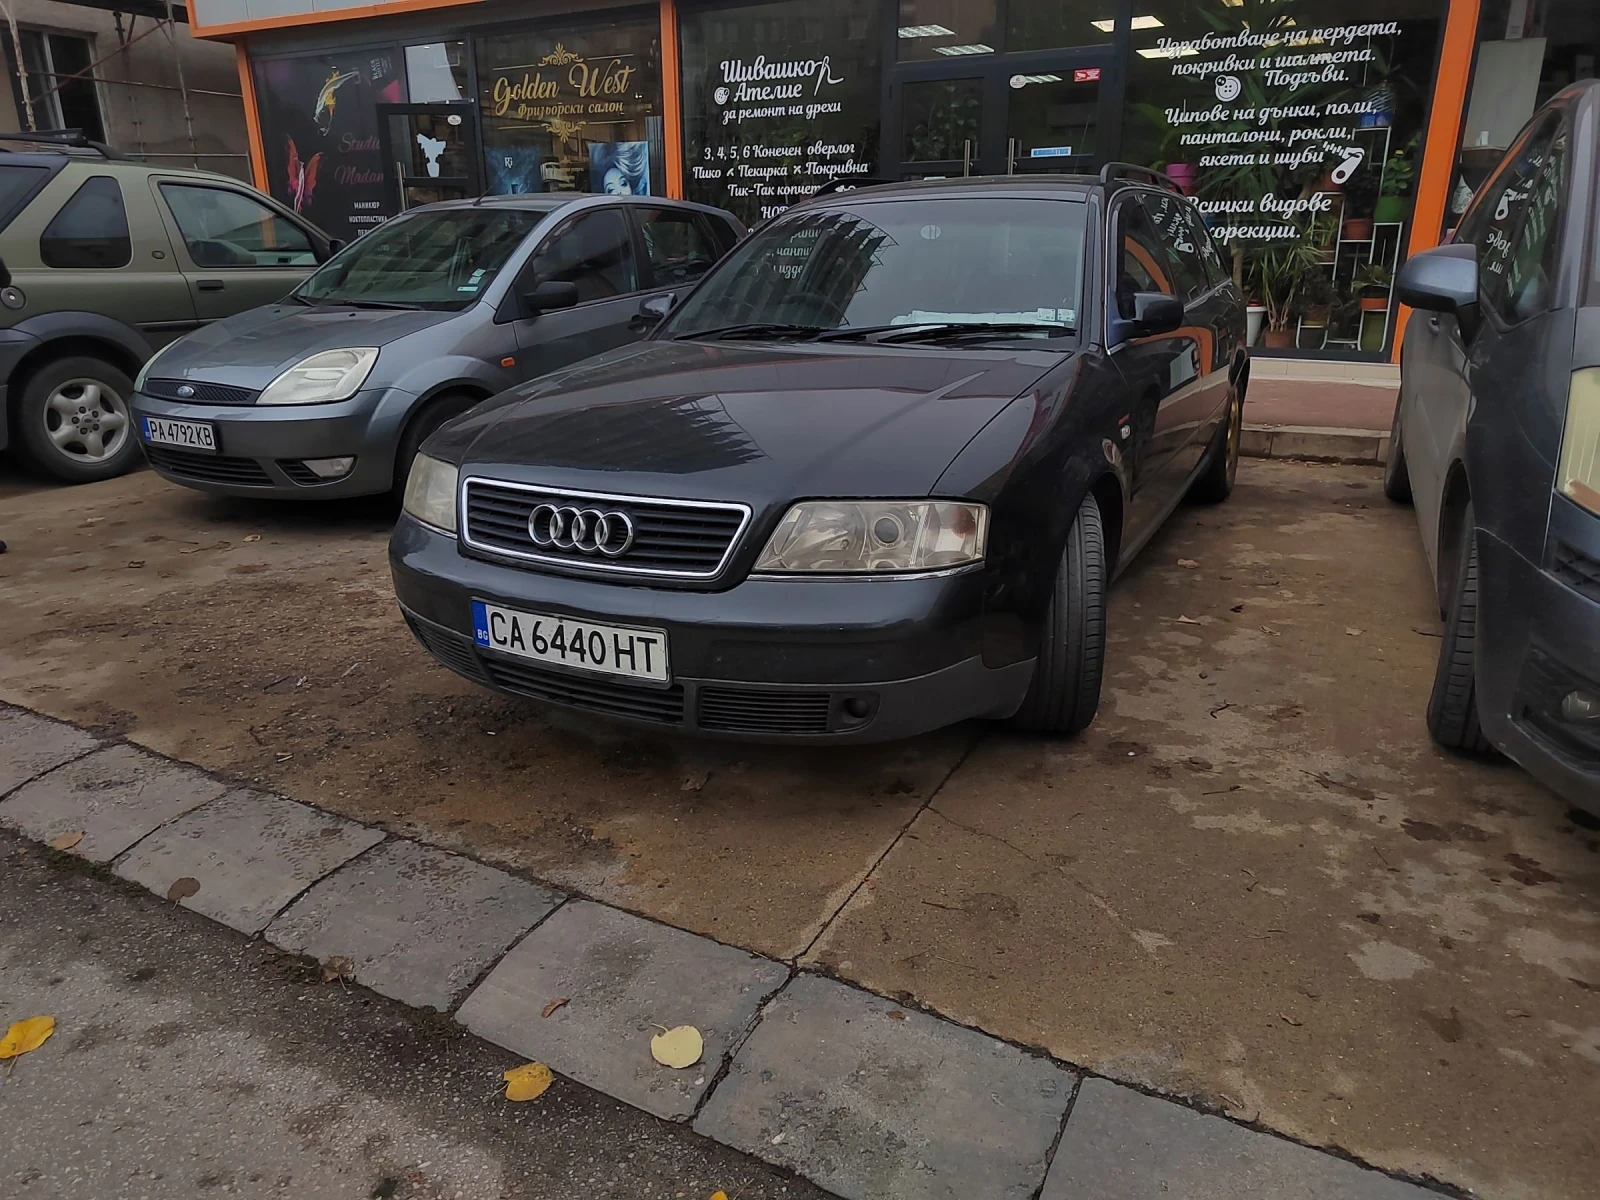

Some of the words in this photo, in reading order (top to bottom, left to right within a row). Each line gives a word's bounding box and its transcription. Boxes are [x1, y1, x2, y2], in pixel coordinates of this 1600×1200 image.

[1156, 27, 1281, 60] Изработване
[1283, 28, 1307, 43] на
[1310, 20, 1402, 46] пердета,
[719, 55, 816, 84] Шивашко
[1171, 53, 1256, 80] покривки
[1259, 57, 1271, 69] и
[1264, 63, 1350, 92] Подгъви.
[493, 73, 560, 116] Golden
[568, 58, 636, 98] West
[733, 82, 803, 102] Ателие
[517, 103, 584, 121] Фризьорски
[588, 102, 624, 114] салон
[722, 109, 736, 126] за
[738, 106, 786, 125] ремонт
[788, 104, 804, 116] на
[805, 101, 842, 120] дрехи
[1164, 104, 1229, 127] Ципове
[1233, 106, 1256, 121] на
[1258, 104, 1321, 126] дънки,
[1325, 101, 1377, 116] поли,
[1180, 129, 1285, 146] панталони,
[1288, 126, 1352, 147] рокли,
[742, 145, 751, 158] 6
[752, 144, 802, 158] Конечен
[807, 140, 855, 160] оверлог
[1199, 151, 1255, 167] якета
[1258, 151, 1270, 165] и
[1274, 145, 1324, 171] шуби
[692, 166, 722, 180] Пико
[737, 164, 788, 182] Пекирка
[804, 159, 868, 180] Покривна
[727, 182, 775, 197] Тик-Так
[1259, 192, 1332, 219] видове
[477, 628, 489, 641] BG
